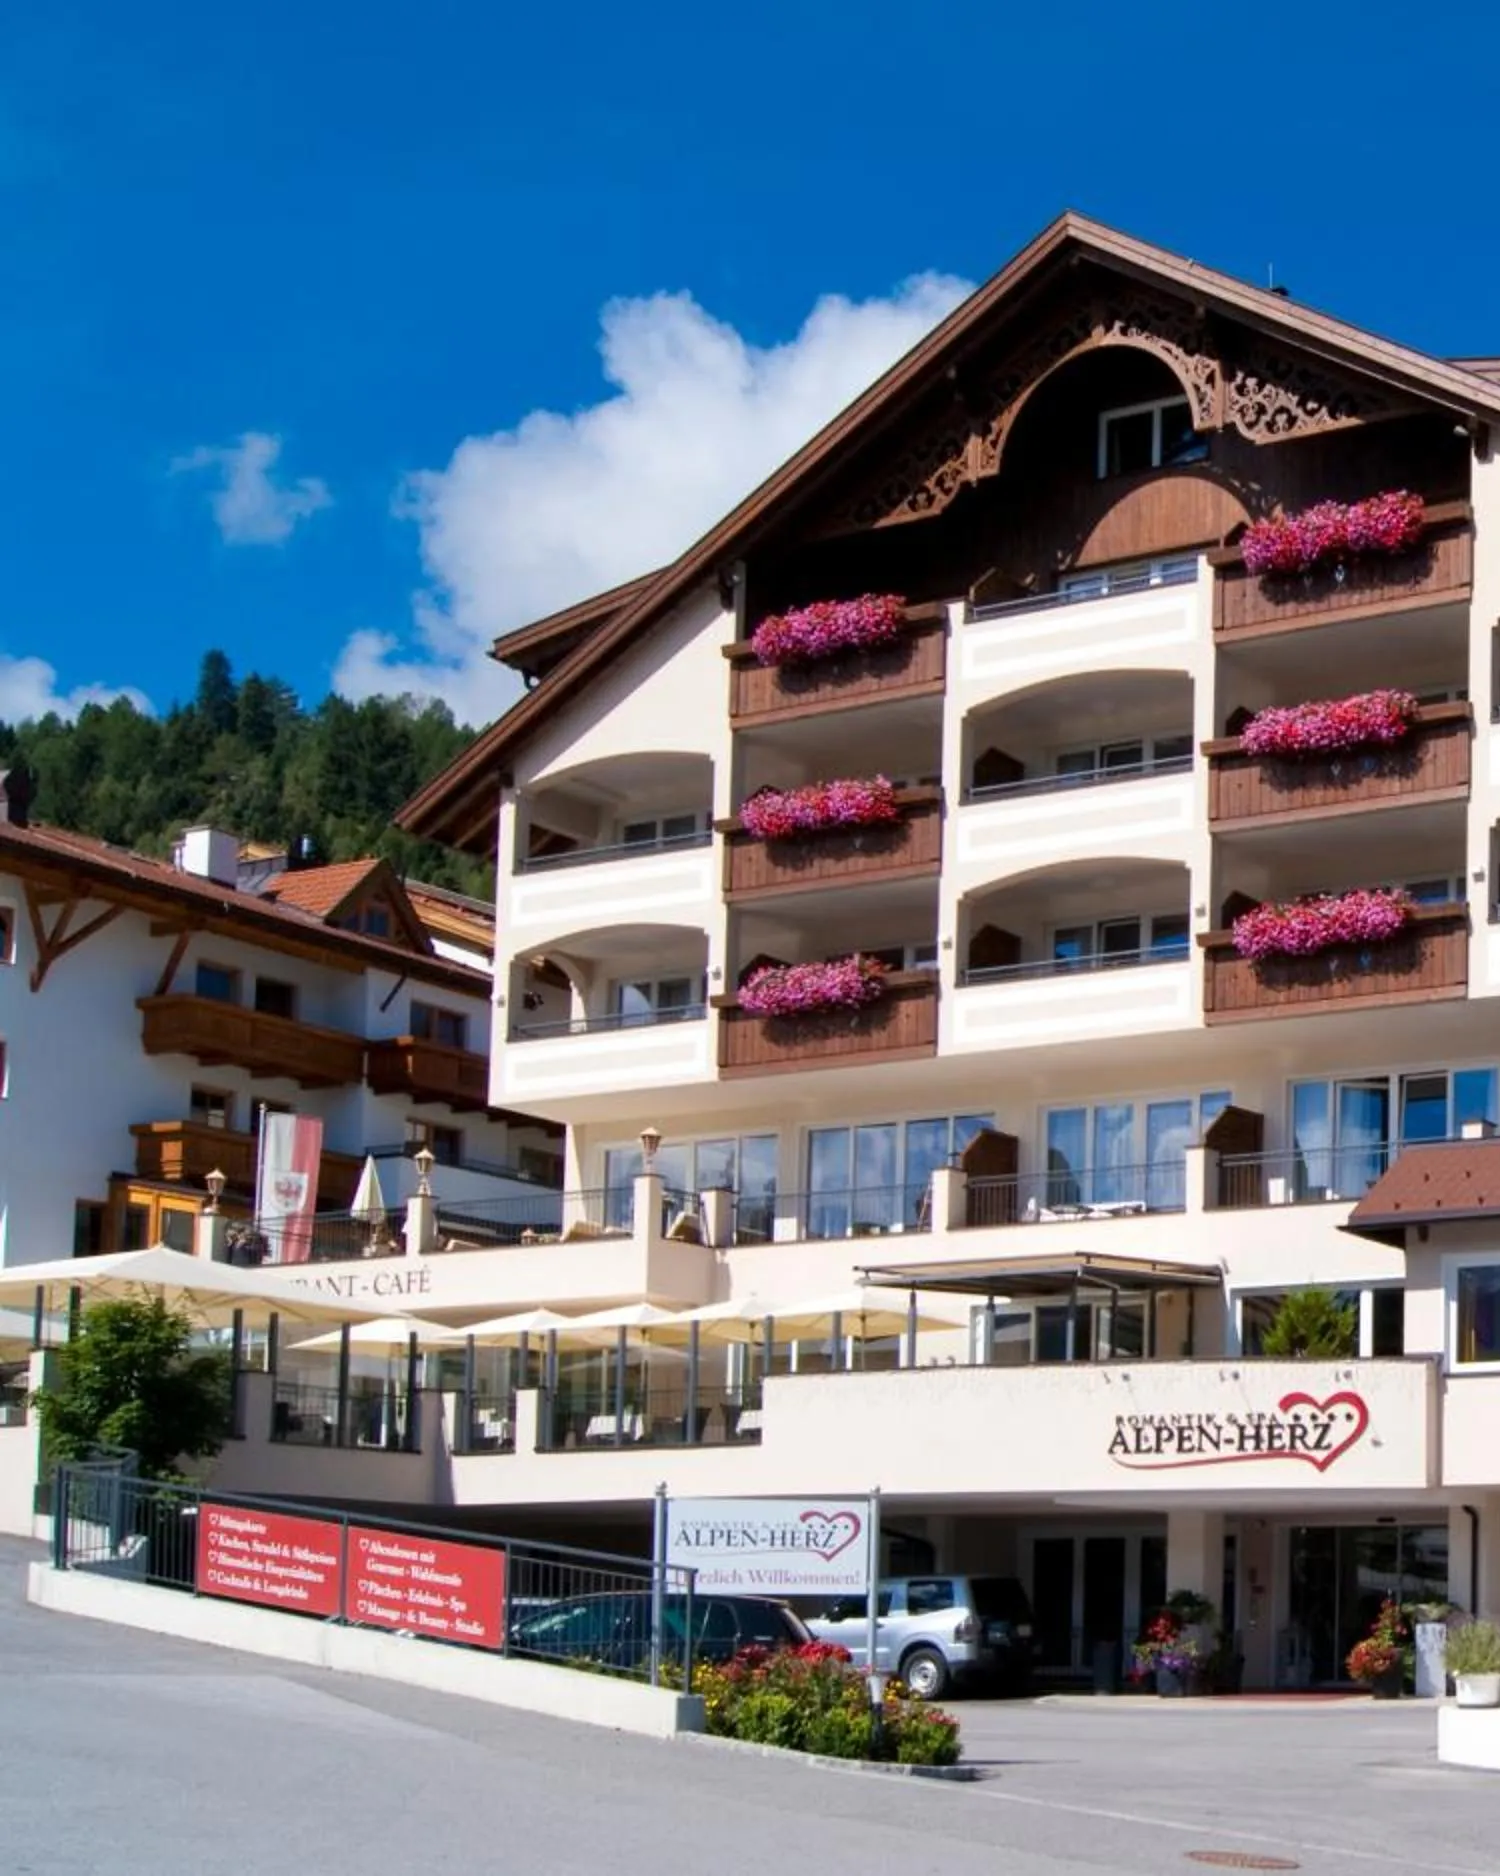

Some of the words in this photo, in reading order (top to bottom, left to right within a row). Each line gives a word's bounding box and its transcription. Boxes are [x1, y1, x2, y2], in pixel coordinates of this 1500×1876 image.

[1115, 1413, 1216, 1425] ROMANTIK
[1246, 1412, 1280, 1425] SPA
[1108, 1423, 1332, 1455] ALPEN-HERZ
[674, 1529, 836, 1548] ALPEN-HERZ
[675, 1568, 743, 1584] erzlich
